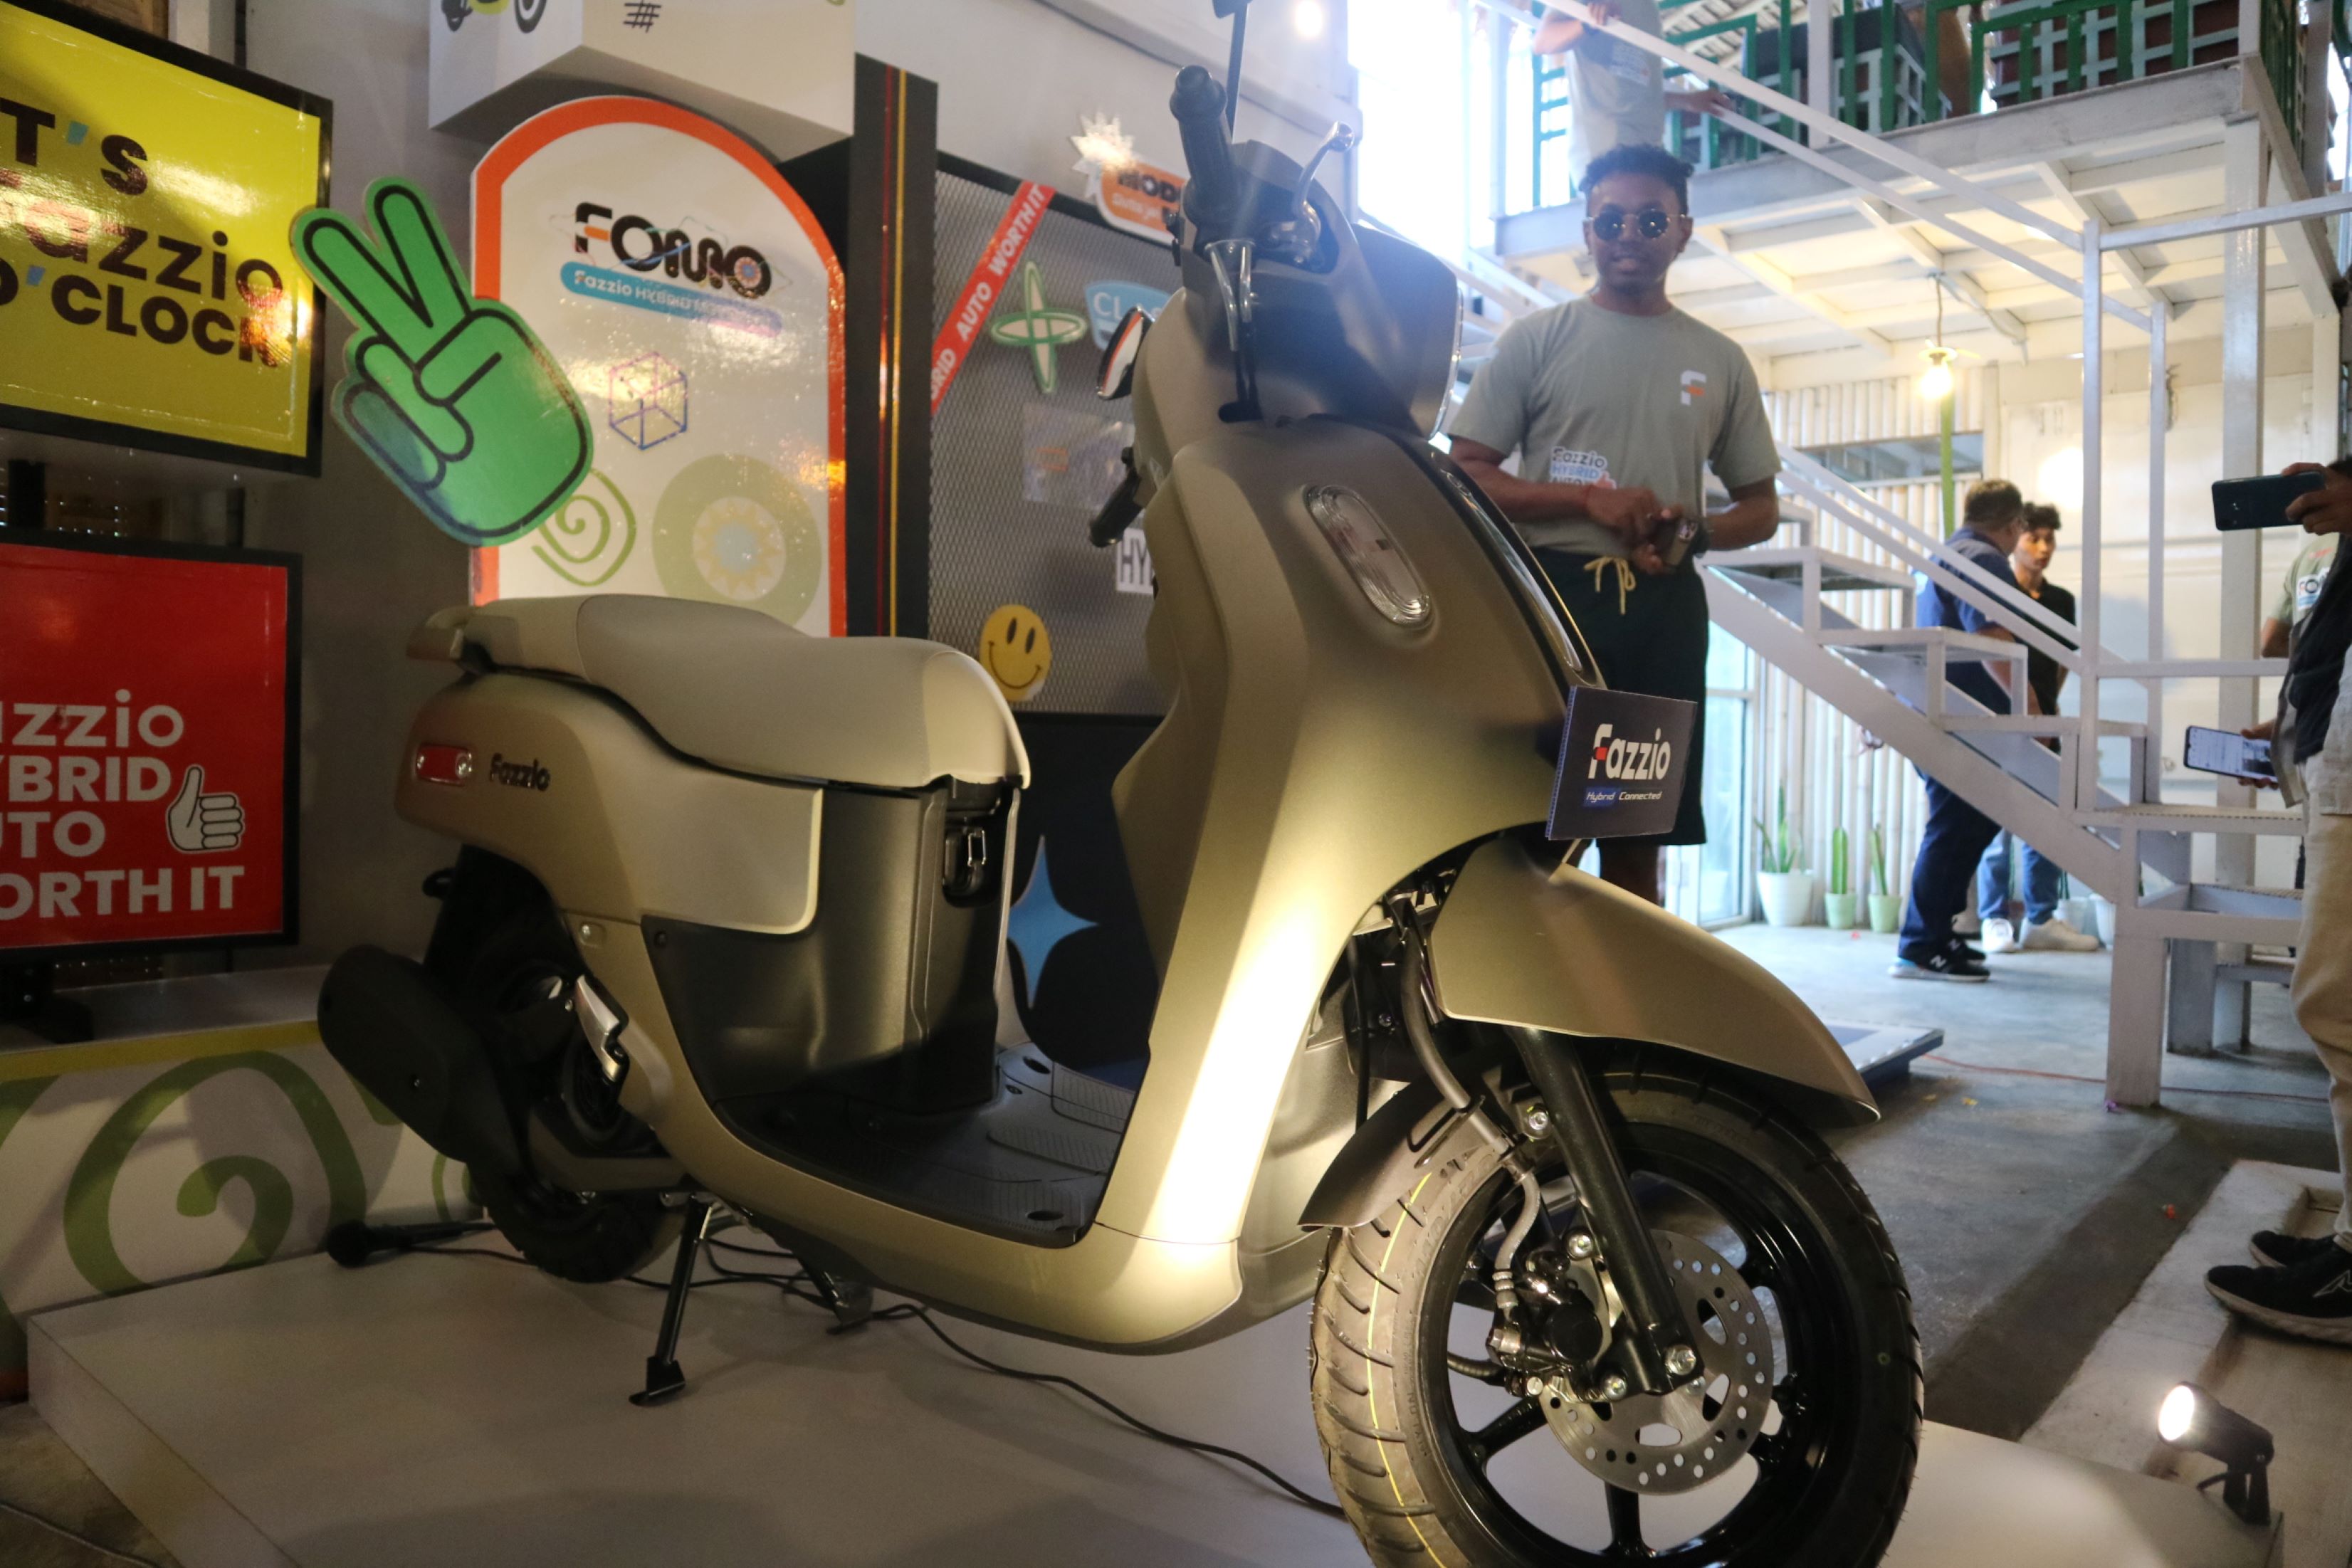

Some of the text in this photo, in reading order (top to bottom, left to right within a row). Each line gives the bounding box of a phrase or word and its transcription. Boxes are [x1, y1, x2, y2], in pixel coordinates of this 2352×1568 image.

[574, 270, 632, 296] Fazzio
[955, 281, 992, 342] AUTO
[988, 202, 1039, 277] WORTH
[1027, 183, 1046, 218] IT
[0, 689, 184, 748] zzio
[490, 752, 551, 791] Fazzio
[1588, 723, 1671, 780] Fazzio
[0, 756, 172, 802] BRID
[1585, 790, 1663, 803] Hybrid Connected
[190, 865, 245, 911] IT
